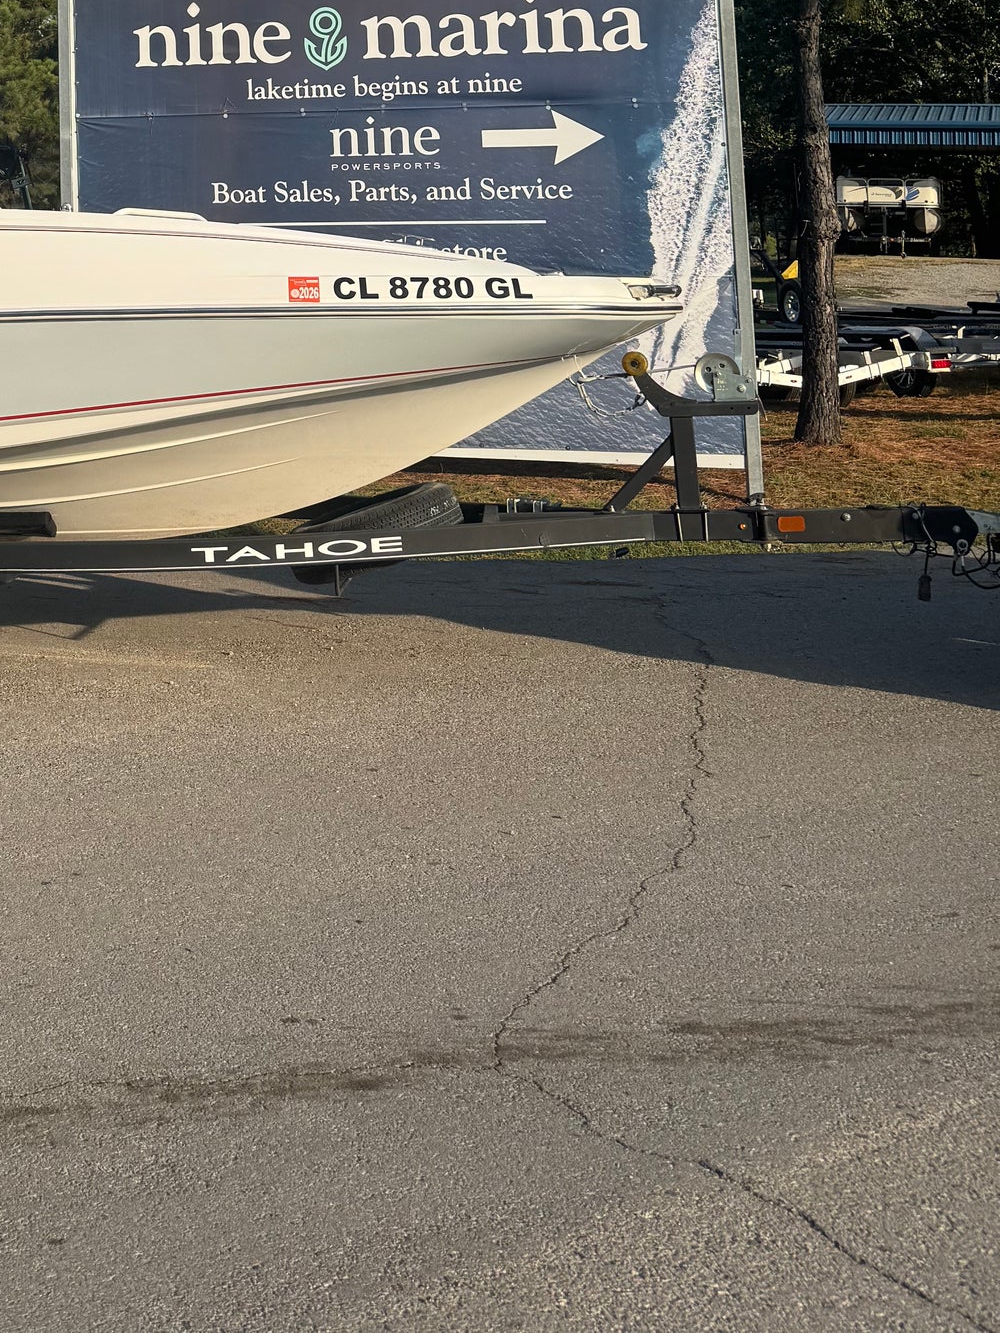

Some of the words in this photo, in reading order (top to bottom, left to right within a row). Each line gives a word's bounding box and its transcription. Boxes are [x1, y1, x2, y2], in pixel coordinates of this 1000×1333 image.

[132, 2, 292, 68] nine
[246, 78, 346, 100] laketime
[353, 74, 429, 101] begins
[437, 77, 460, 95] at
[467, 72, 523, 93] nine
[329, 116, 441, 157] nine
[331, 162, 441, 171] POWERSPORTS
[211, 181, 267, 204] Boat
[274, 179, 341, 206] Sales,
[347, 179, 418, 205] Parts,
[426, 177, 472, 201] and
[479, 177, 573, 201] Service
[299, 286, 319, 299] 2026
[332, 277, 379, 300] CL
[389, 276, 475, 299] 8780
[484, 277, 534, 299] GL
[190, 536, 403, 563] TAHOE
